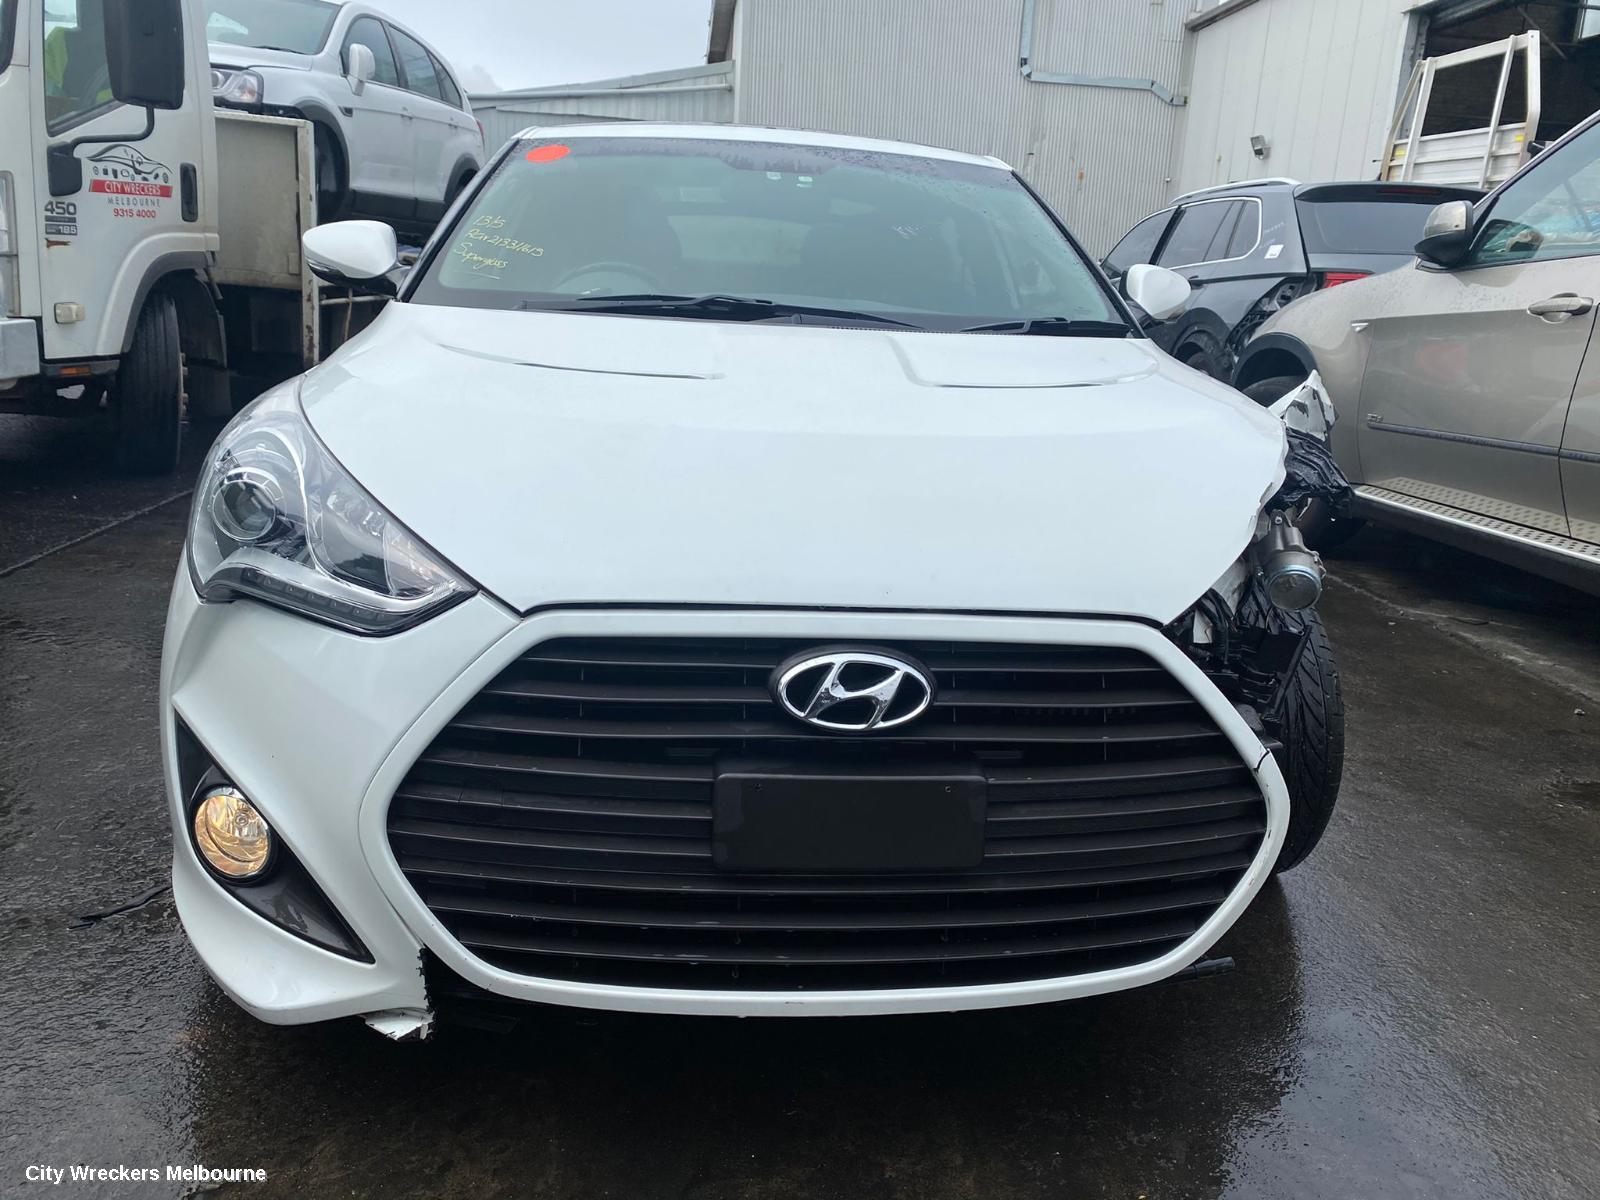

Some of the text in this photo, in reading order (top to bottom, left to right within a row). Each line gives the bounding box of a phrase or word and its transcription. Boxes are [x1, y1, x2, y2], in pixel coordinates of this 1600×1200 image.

[104, 181, 161, 195] CITY WRECKERS
[108, 196, 160, 206] MELBOURNE
[44, 200, 77, 215] 450
[113, 208, 156, 218] 9315 4000
